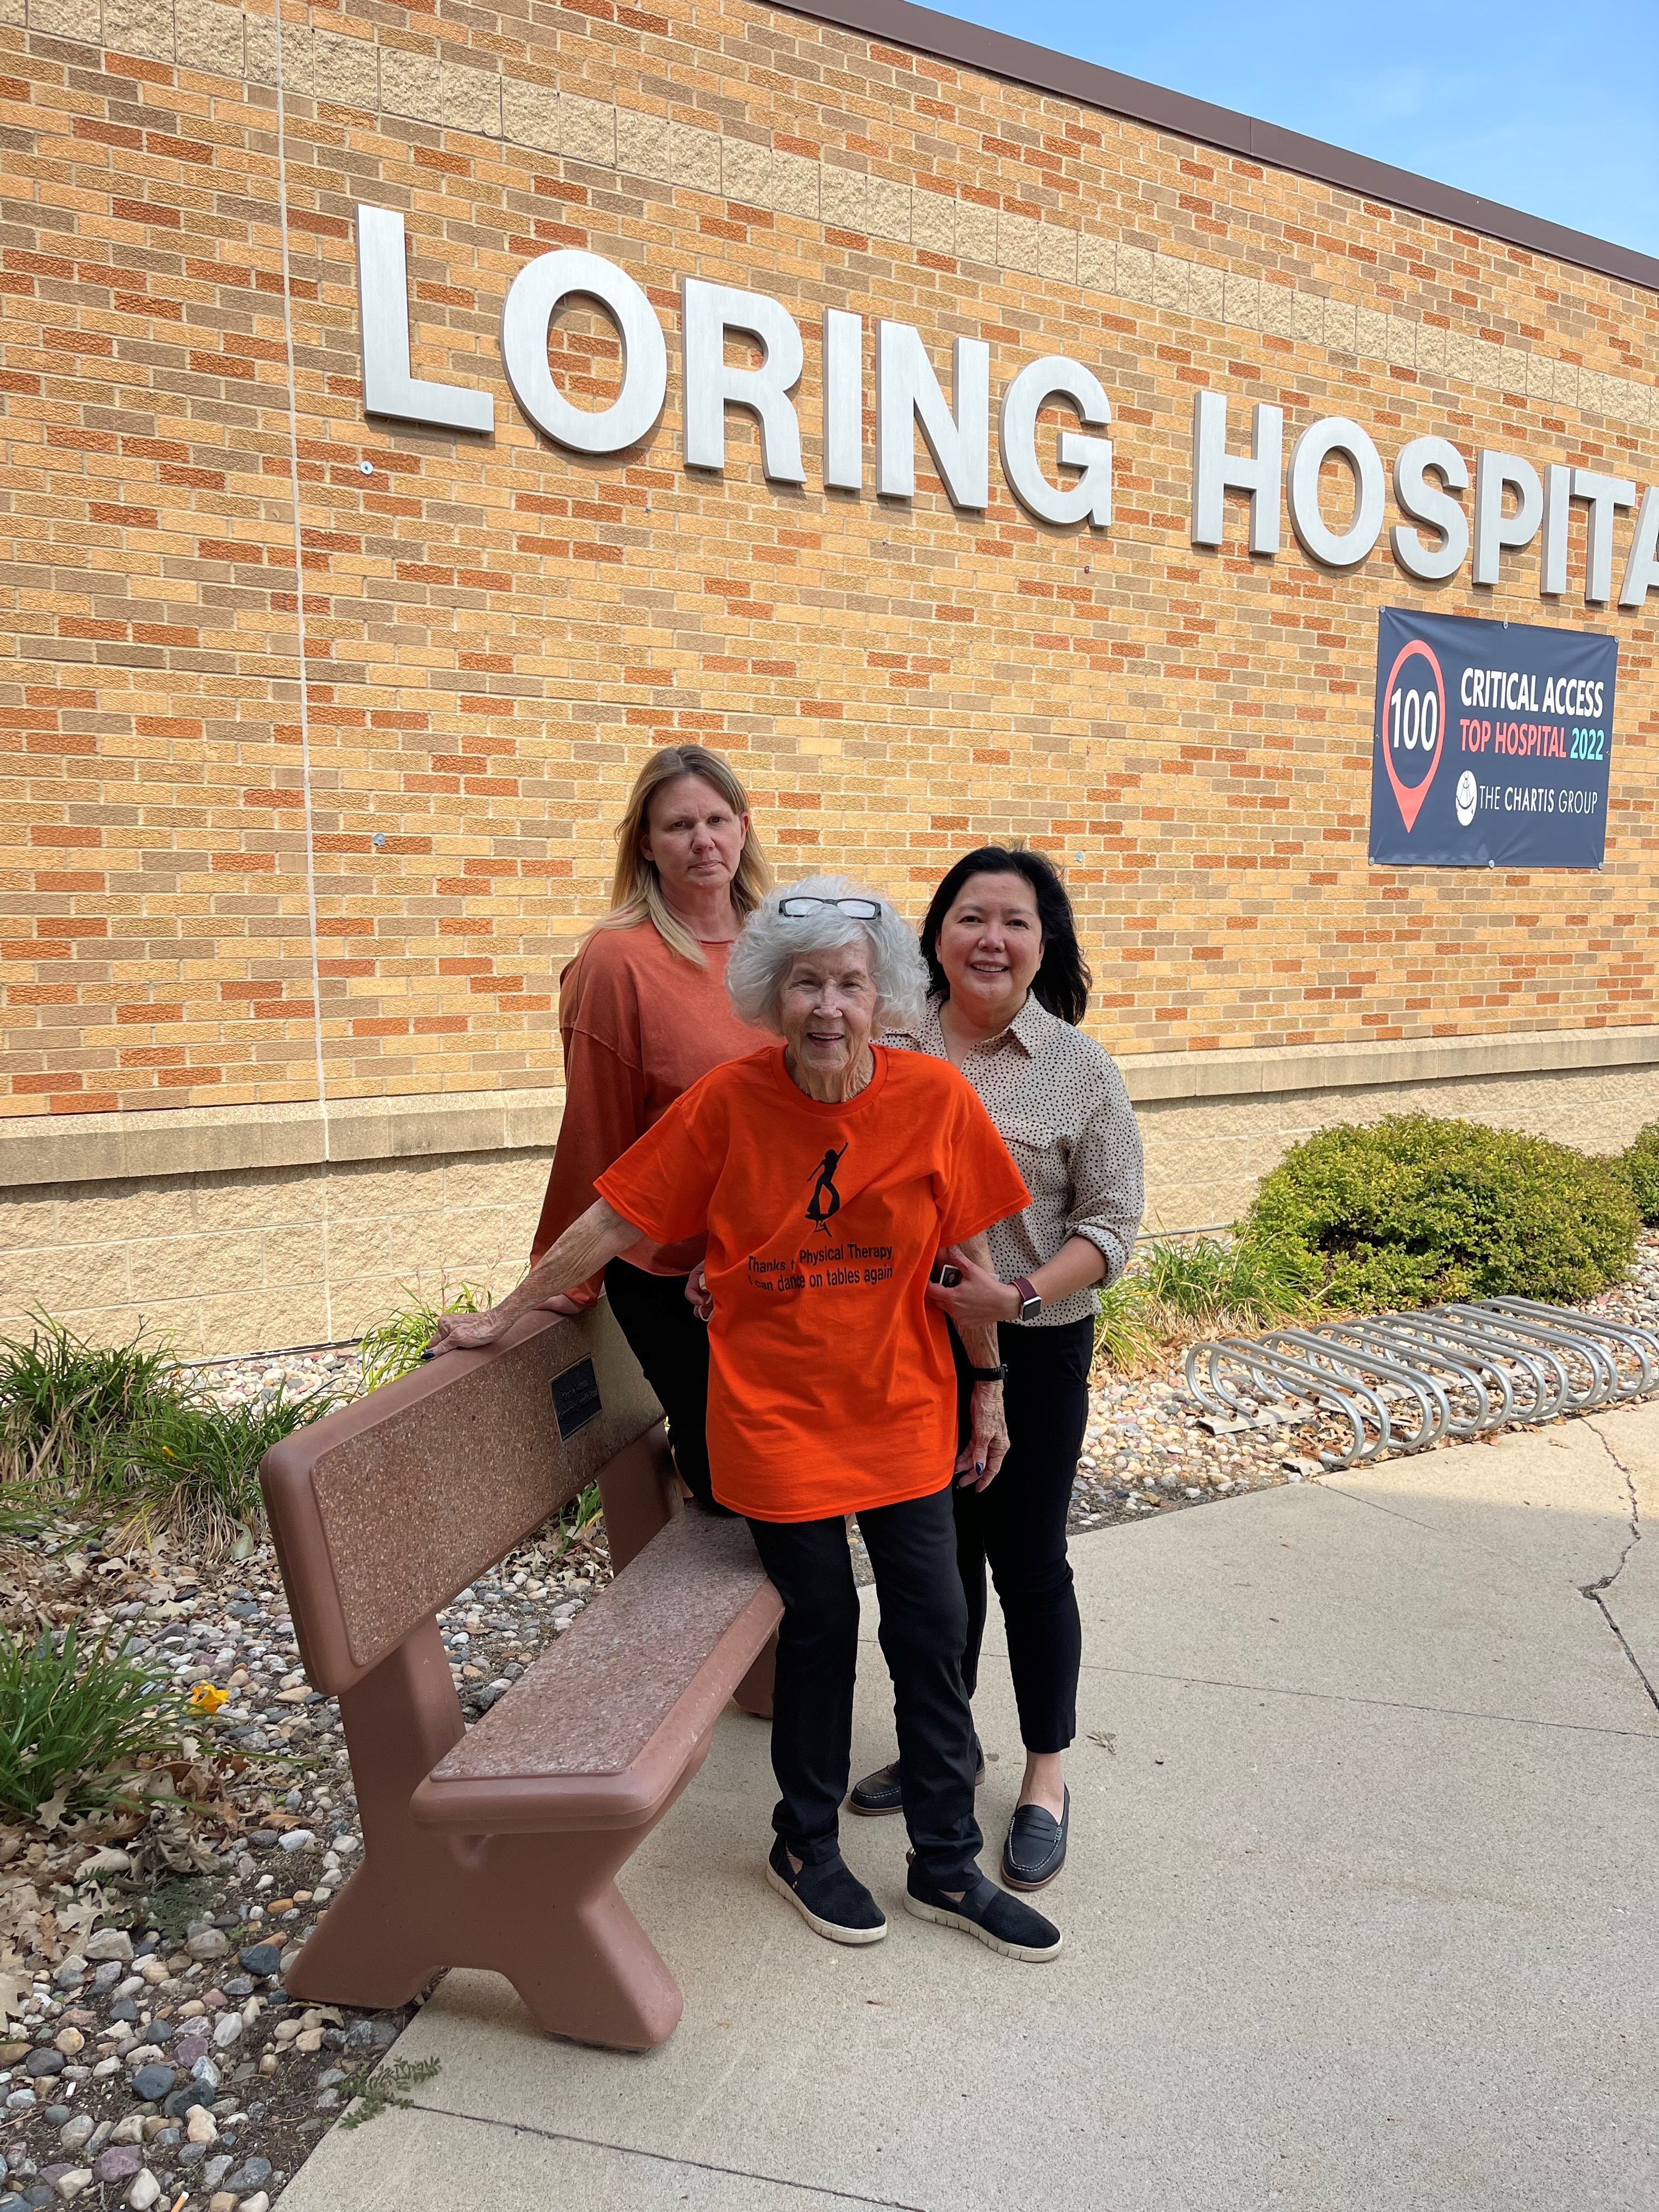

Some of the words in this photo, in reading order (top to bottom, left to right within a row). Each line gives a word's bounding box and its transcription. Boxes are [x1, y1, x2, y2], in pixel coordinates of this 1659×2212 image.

[356, 203, 1113, 527] LORING
[1192, 390, 1659, 606] HOSPITA
[1460, 667, 1539, 713] CRITICAL
[1542, 676, 1604, 718] ACCESS
[1391, 687, 1437, 751] 100
[1460, 719, 1491, 752] TOP
[1494, 721, 1566, 758] HOSPITAL
[1570, 727, 1605, 760] 2022
[1480, 785, 1500, 811] THE
[1504, 786, 1554, 813] CHARTIS
[1558, 790, 1598, 814] GROUP
[748, 1255, 786, 1273] Thanks
[791, 1259, 795, 1270] t
[799, 1243, 843, 1266] Physical
[847, 1244, 893, 1260] Therapy
[748, 1274, 752, 1285] I
[754, 1280, 774, 1292] can
[777, 1274, 805, 1292] dance
[809, 1273, 822, 1288] on
[826, 1267, 860, 1286] tables
[864, 1263, 893, 1285] again
